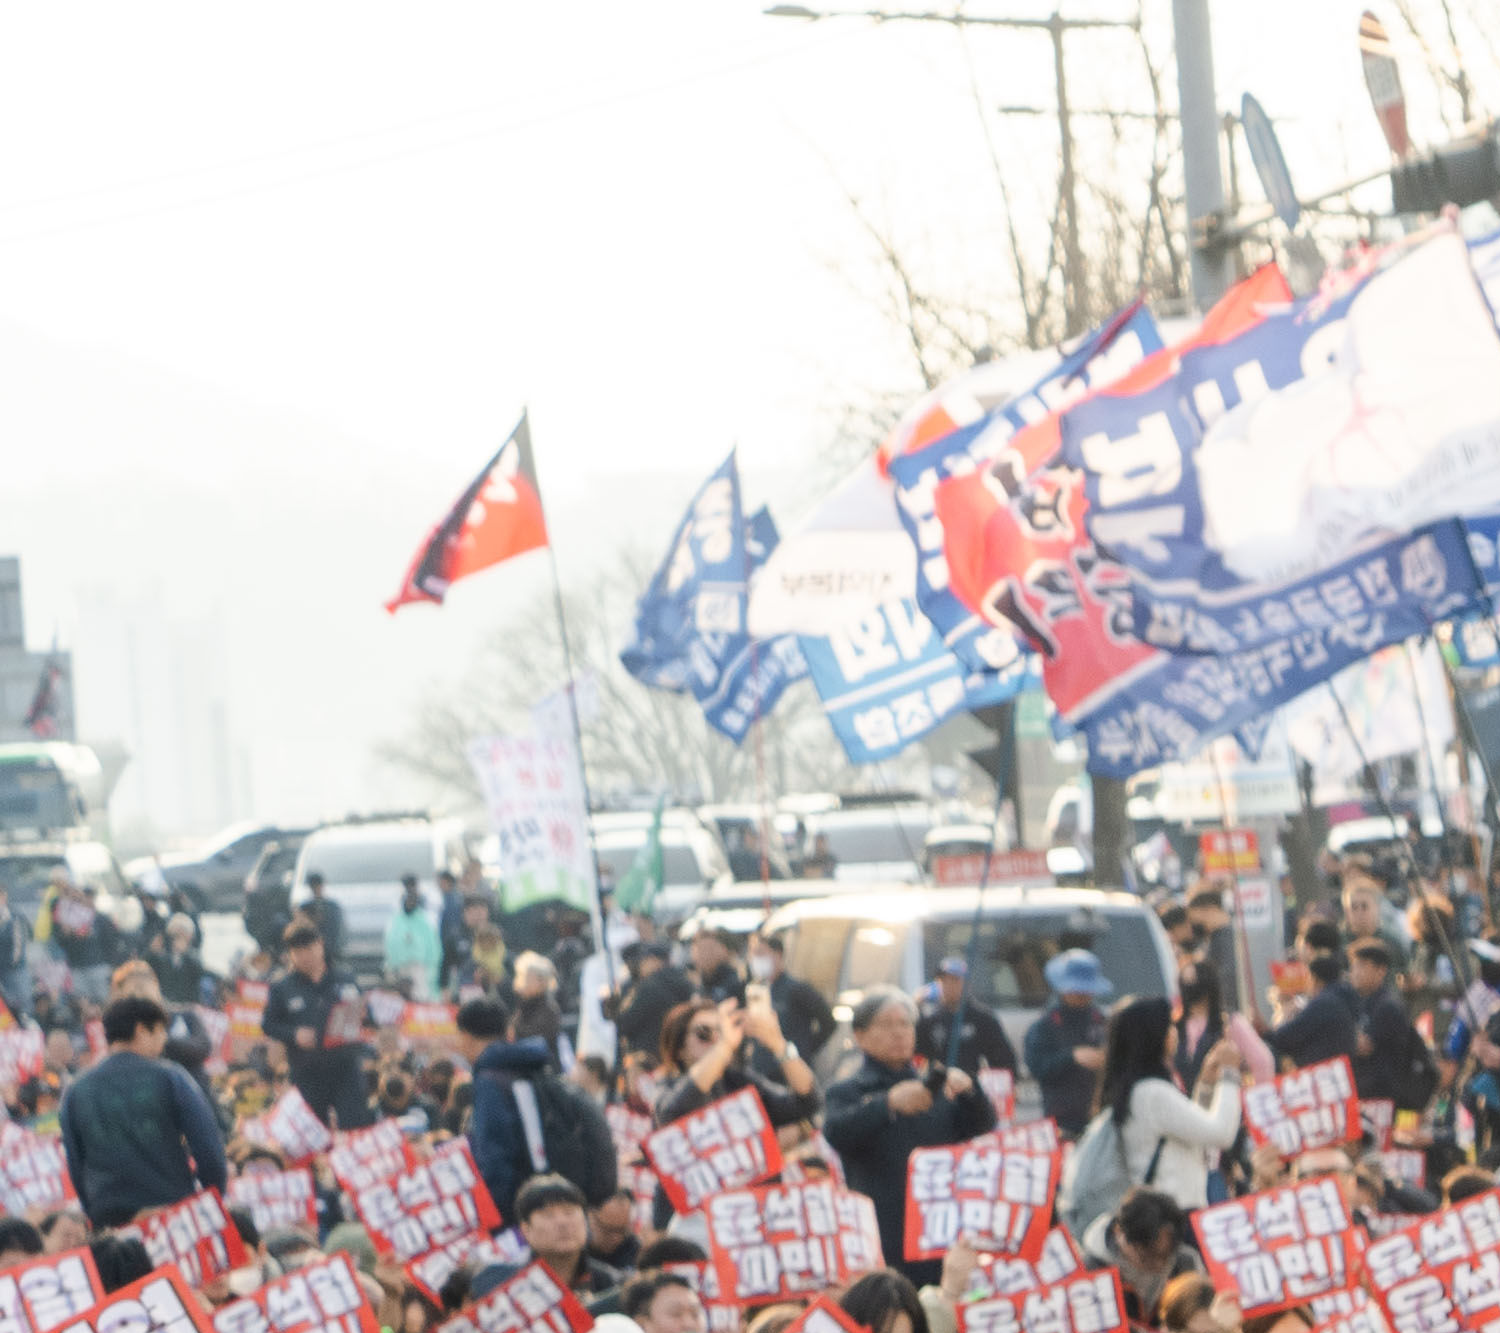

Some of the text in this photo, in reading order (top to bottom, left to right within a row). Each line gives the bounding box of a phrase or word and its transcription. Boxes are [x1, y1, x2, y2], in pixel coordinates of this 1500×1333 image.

[910, 1149, 1051, 1204] 윤석열
[1200, 1180, 1348, 1263] 윤석열
[1228, 1238, 1348, 1310] 파면!
